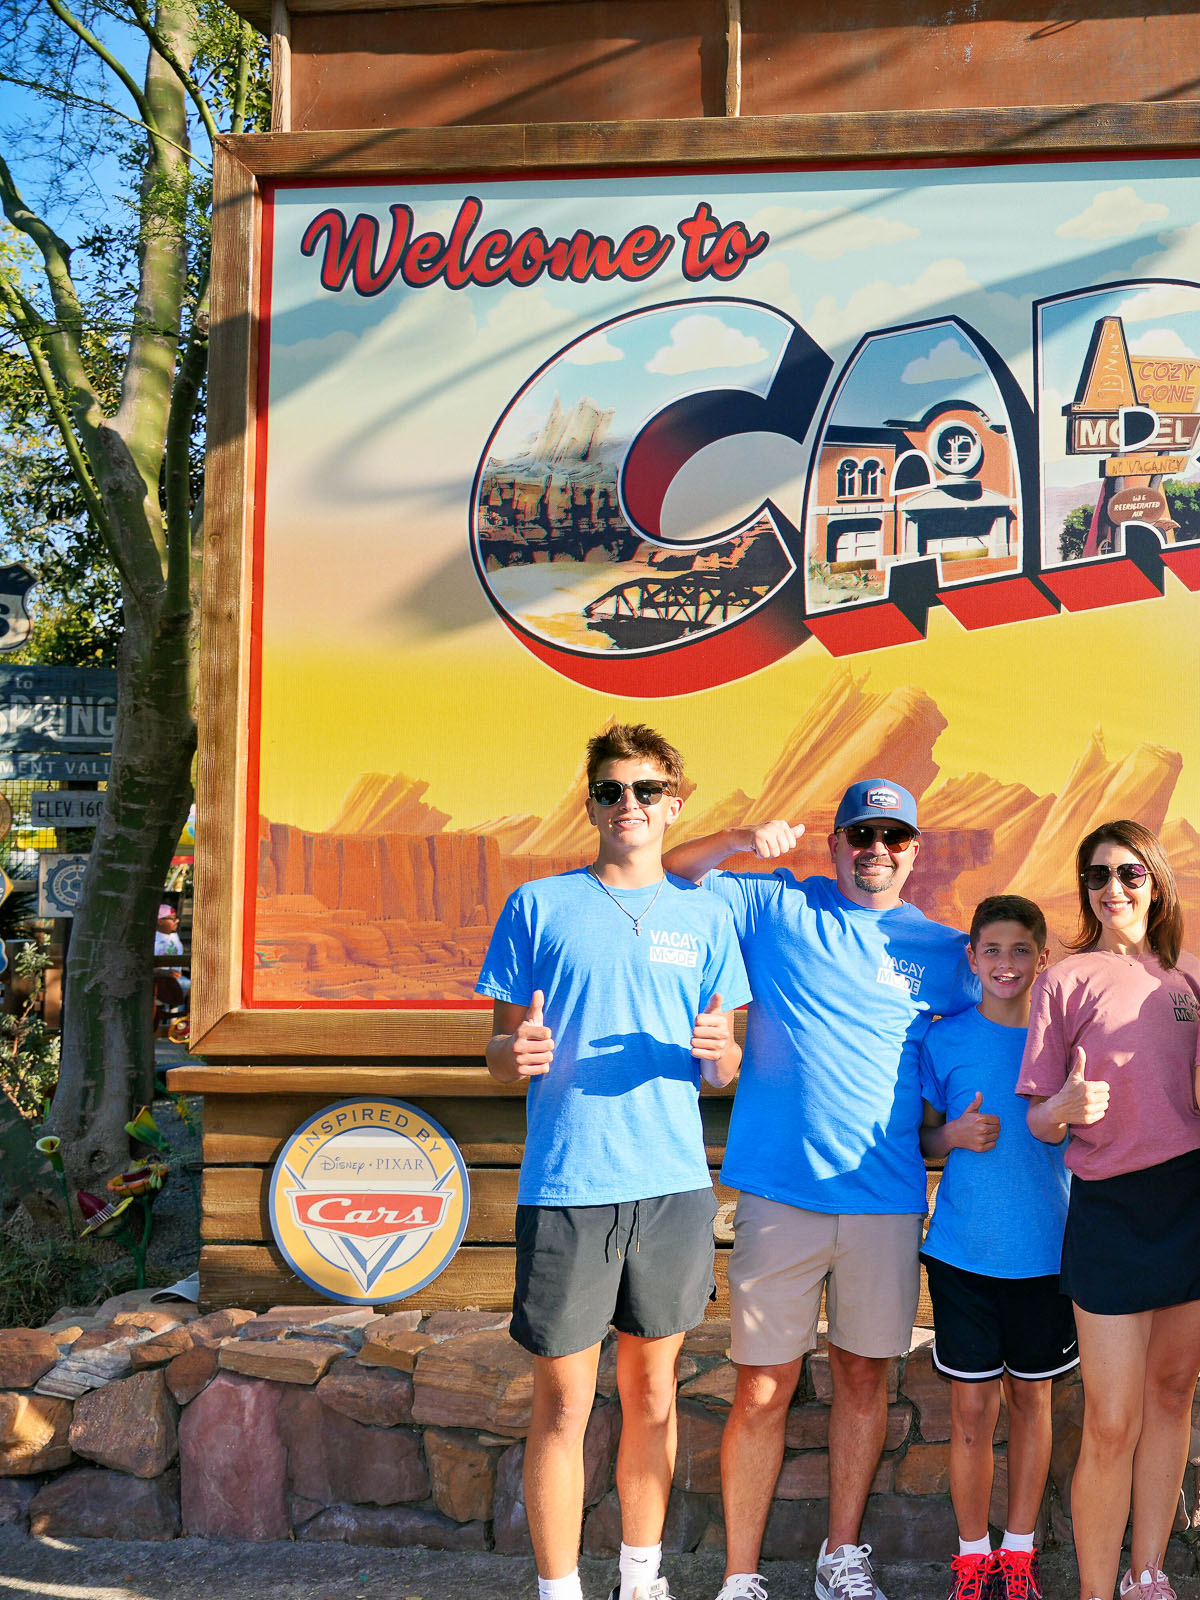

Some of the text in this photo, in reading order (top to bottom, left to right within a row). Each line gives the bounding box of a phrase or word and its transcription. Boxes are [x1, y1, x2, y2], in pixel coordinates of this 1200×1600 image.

[300, 196, 770, 297] Welcome to
[1140, 362, 1197, 382] COZY
[1140, 384, 1196, 403] CONE
[1080, 418, 1192, 446] MEL
[1125, 457, 1185, 474] VACANCY
[0, 694, 117, 736] PRING
[37, 801, 75, 818] ELEV.
[650, 929, 699, 950] VACAY
[651, 947, 697, 967] MODE
[880, 952, 926, 979] VACAY
[877, 969, 921, 994] MODE
[299, 1108, 442, 1154] INSPIRED BY
[317, 1154, 425, 1175] Disney PIXAR
[306, 1197, 430, 1224] Cars
